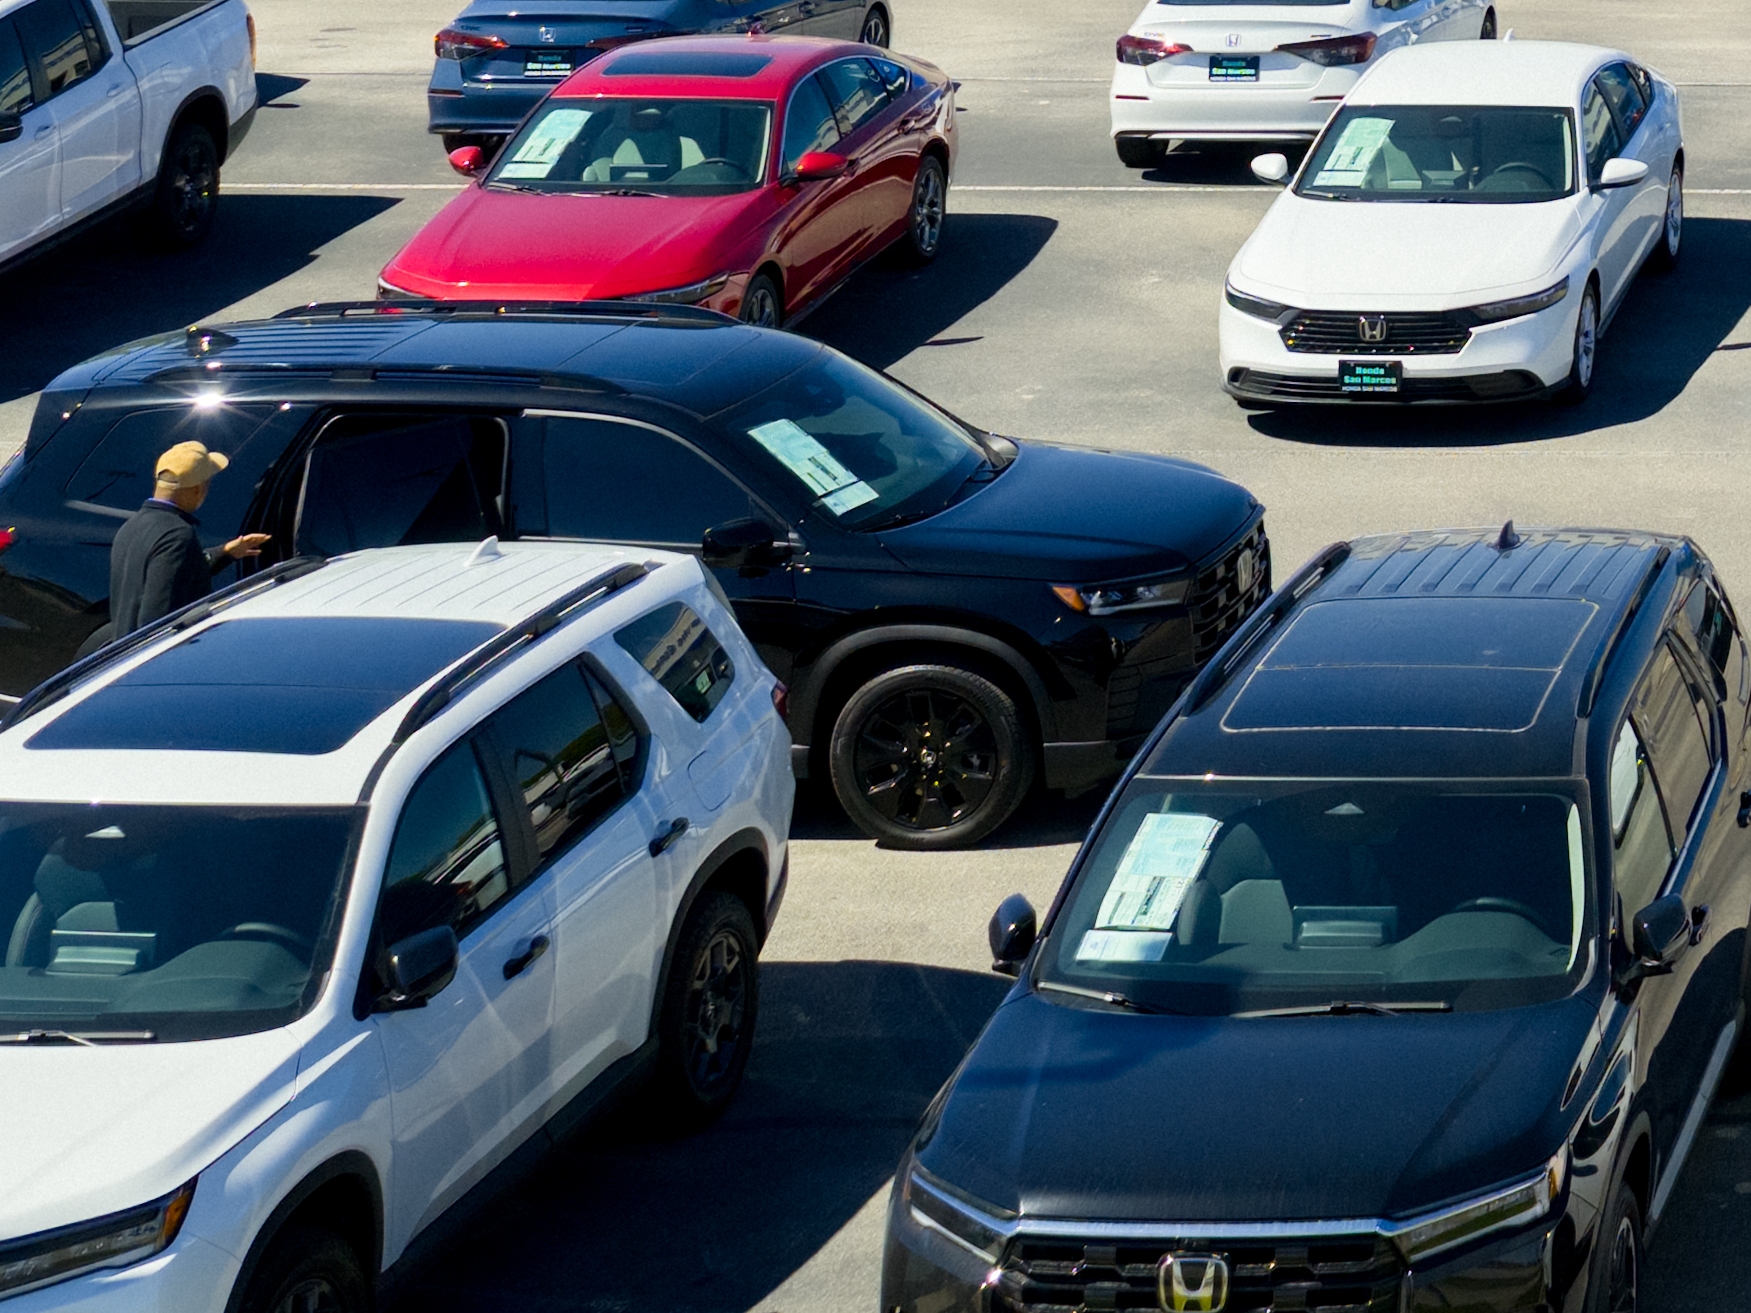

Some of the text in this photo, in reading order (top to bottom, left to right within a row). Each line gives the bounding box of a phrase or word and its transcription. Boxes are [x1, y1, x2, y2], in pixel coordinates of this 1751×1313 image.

[1355, 366, 1384, 375] Honda
[1344, 375, 1396, 384] San Marcos
